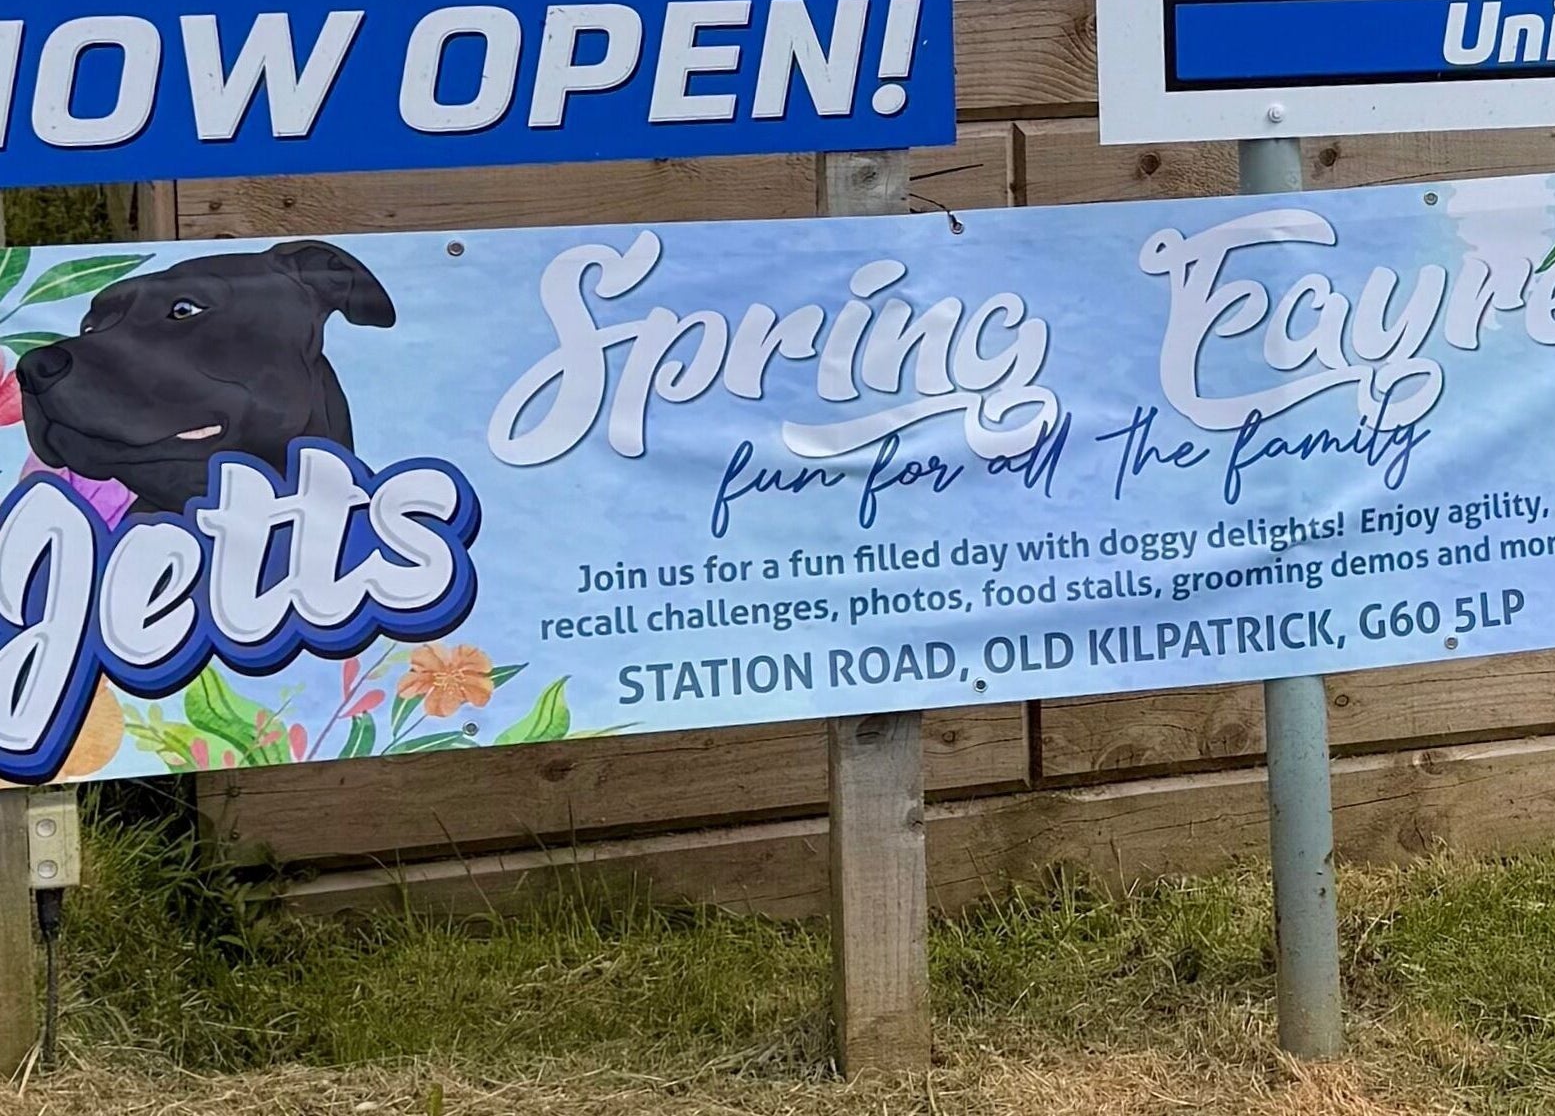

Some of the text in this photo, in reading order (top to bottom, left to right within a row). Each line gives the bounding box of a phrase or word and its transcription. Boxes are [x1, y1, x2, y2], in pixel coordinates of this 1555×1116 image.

[0, 10, 366, 149] OW
[487, 229, 1061, 467] Spring
[711, 390, 1432, 539] fun for all the family
[0, 447, 458, 751] Jetts
[541, 604, 638, 641] recall
[646, 595, 839, 633] challenges,
[849, 588, 973, 626] photos,
[982, 577, 1056, 608] food
[1066, 571, 1162, 602] stalls,
[1172, 557, 1324, 601] grooming
[1331, 546, 1429, 579] demos
[1437, 535, 1490, 566] and
[577, 490, 1551, 594] Join us for a fun filled day with doggy delights! Enjoy agility,
[618, 588, 1526, 706] STATION ROAD, OLD KILPATRICK, G60 5LP
